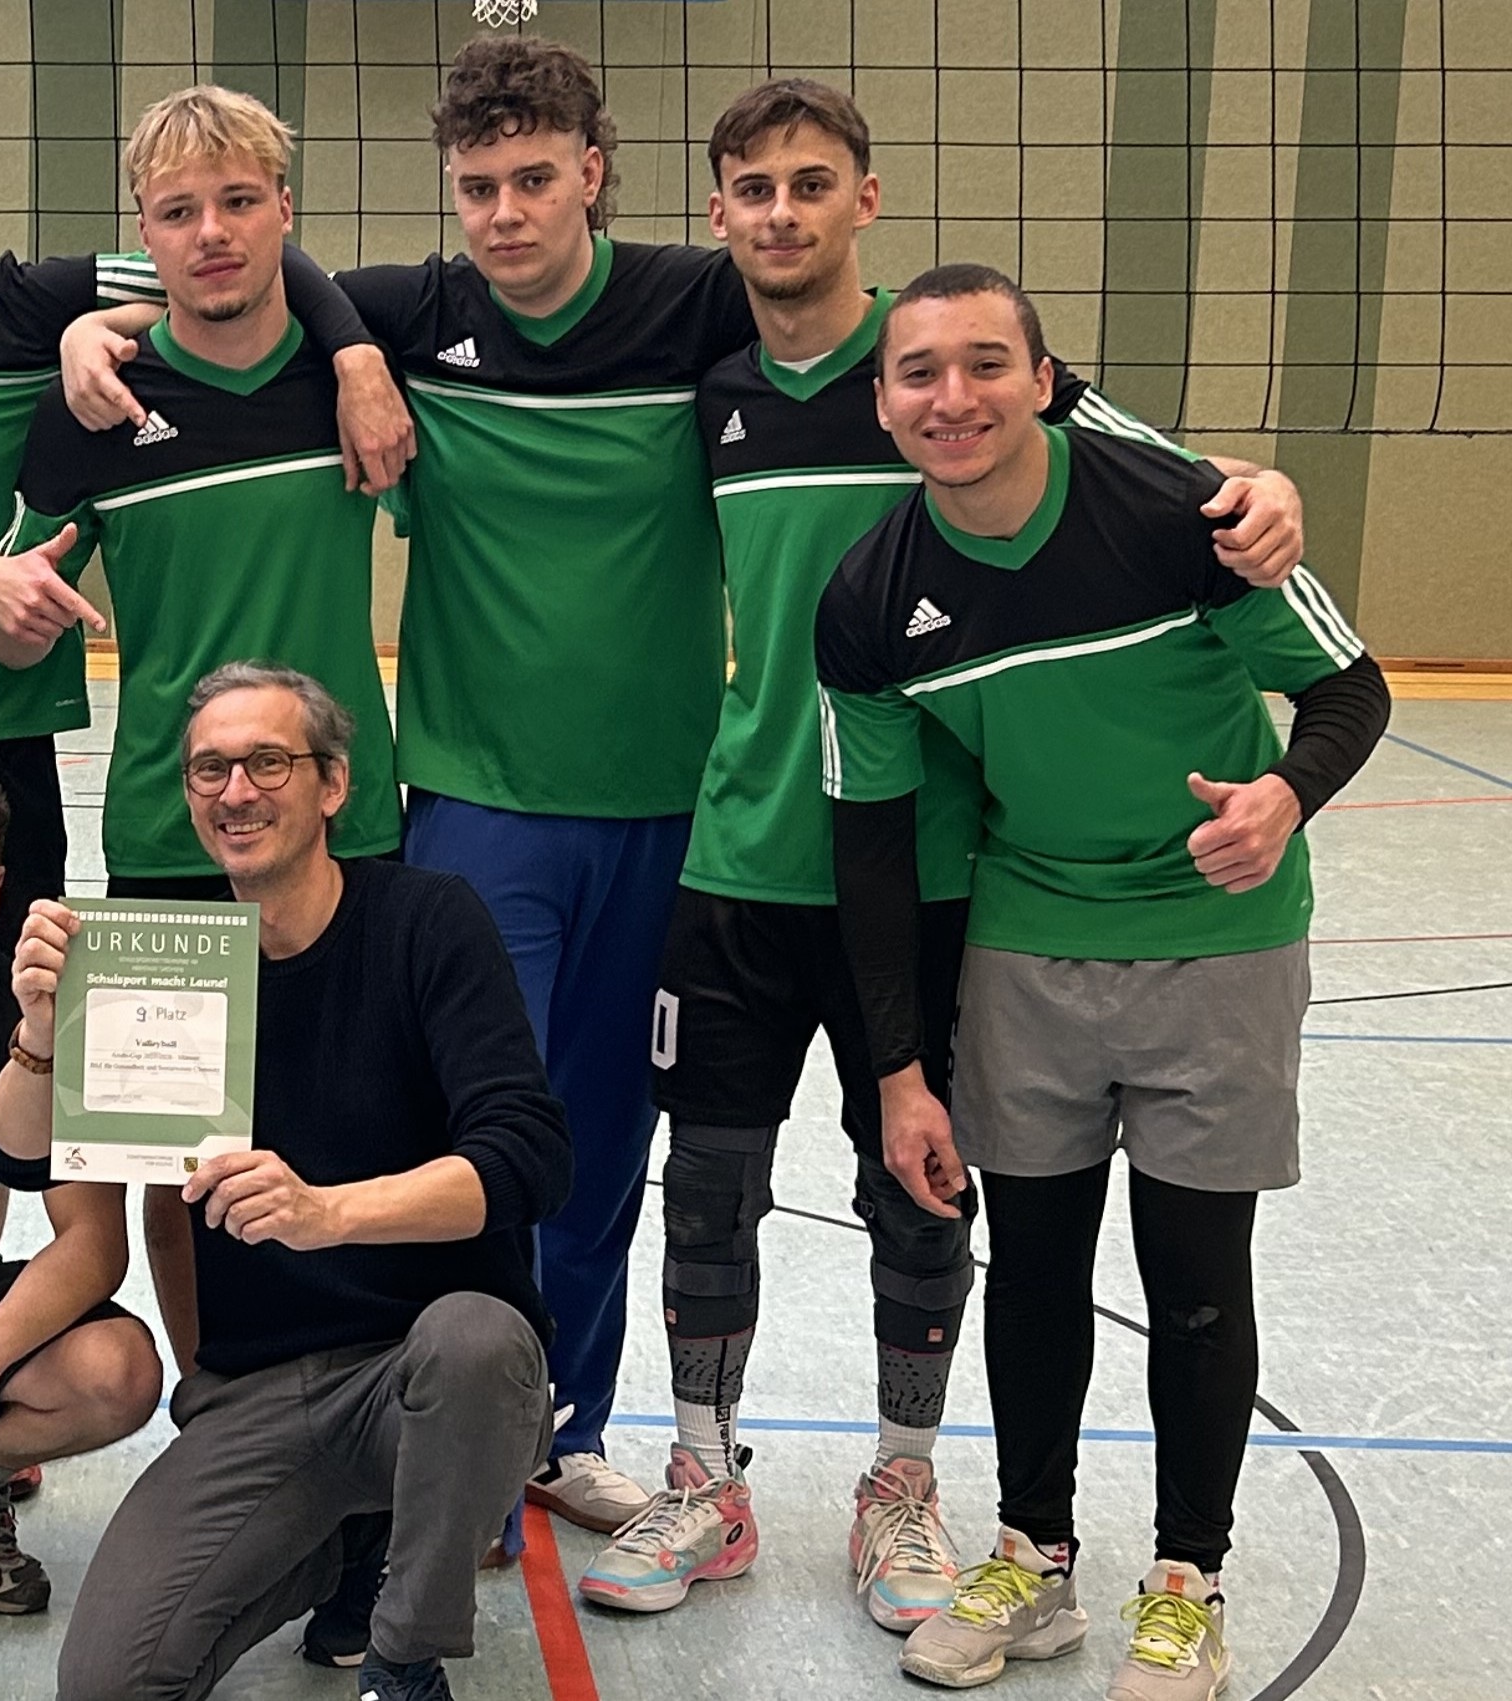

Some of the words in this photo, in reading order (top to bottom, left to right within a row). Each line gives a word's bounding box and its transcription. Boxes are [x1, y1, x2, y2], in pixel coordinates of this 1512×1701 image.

[437, 351, 481, 368] adidas
[133, 426, 179, 447] adidas
[905, 614, 952, 638] adidas
[87, 931, 231, 956] URKUNDE
[86, 972, 148, 988] Schulsport
[150, 975, 187, 987] macht
[155, 1006, 188, 1021] Platz
